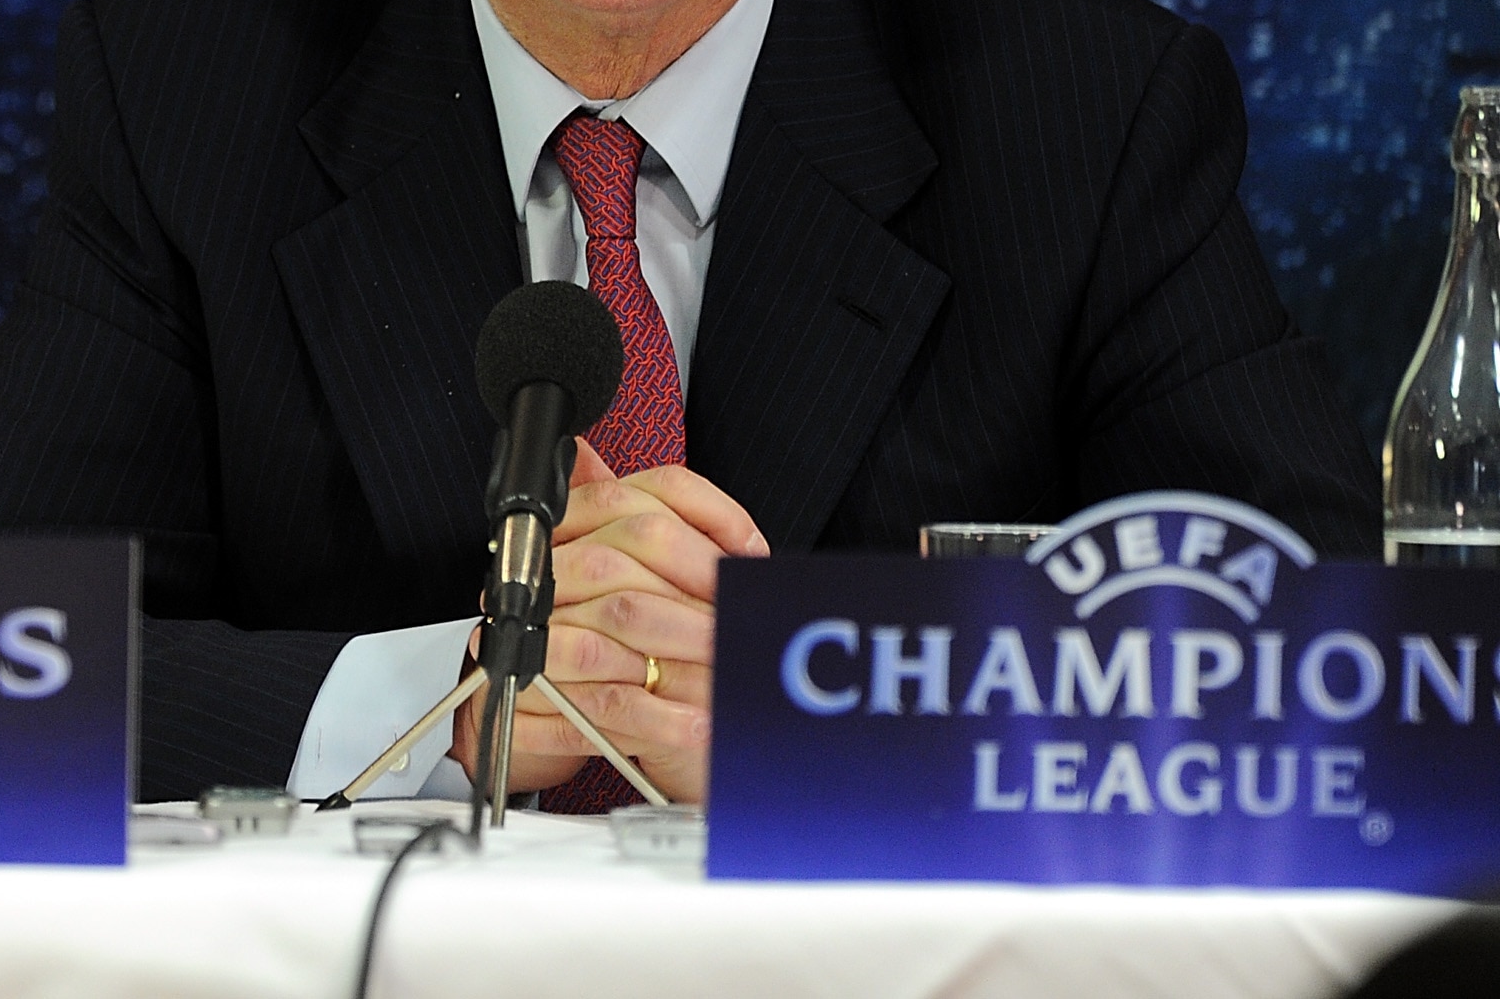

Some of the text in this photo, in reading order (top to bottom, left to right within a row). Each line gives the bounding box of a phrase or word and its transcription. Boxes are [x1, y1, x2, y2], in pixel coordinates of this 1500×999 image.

[1044, 513, 1280, 605] UEFA
[780, 618, 1500, 725] CHAMPION
[972, 739, 1367, 819] LEAGUE
